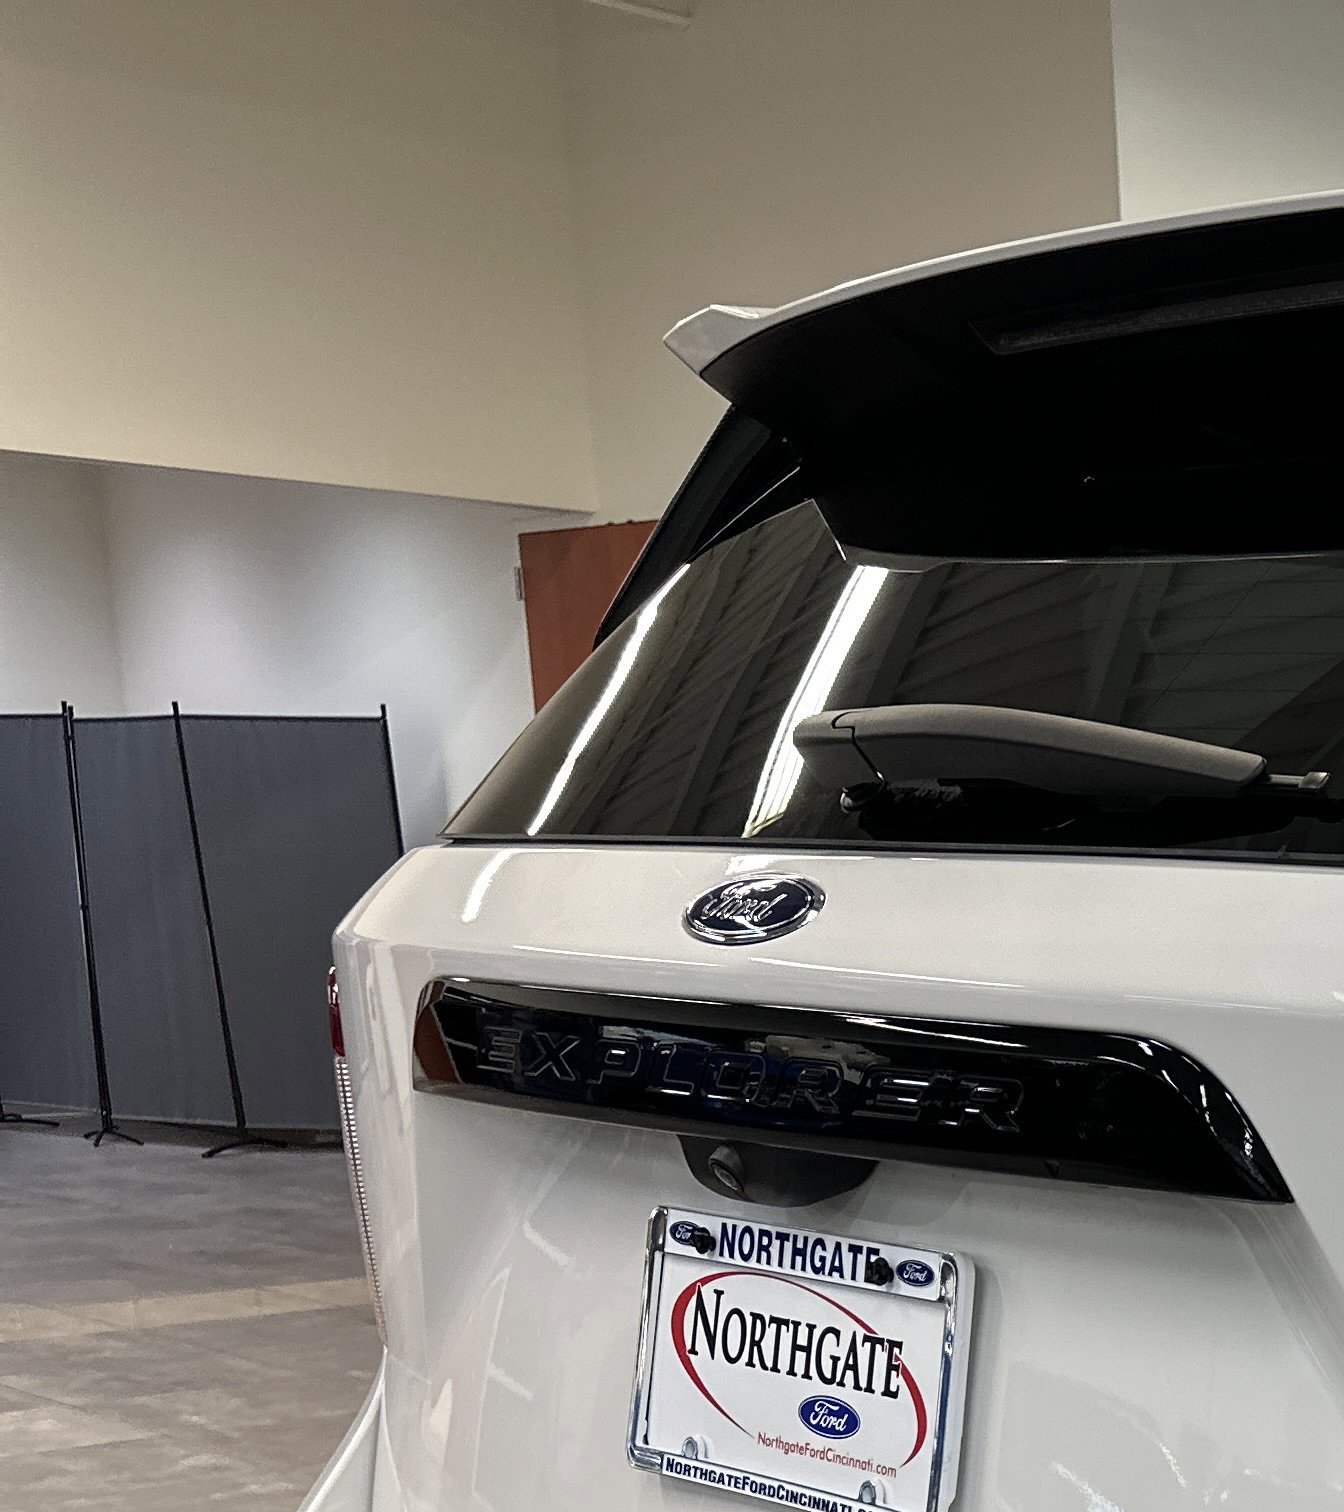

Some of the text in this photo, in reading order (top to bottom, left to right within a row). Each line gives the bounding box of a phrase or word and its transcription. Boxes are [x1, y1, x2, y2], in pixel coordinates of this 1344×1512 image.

[700, 880, 789, 923] Ford
[476, 1023, 1025, 1133] EXPLORER
[903, 1263, 927, 1282] Ford
[688, 1281, 904, 1400] NORTHGATE
[809, 1401, 849, 1431] Ford
[757, 1432, 897, 1478] NorthgateFordCincinnati.com
